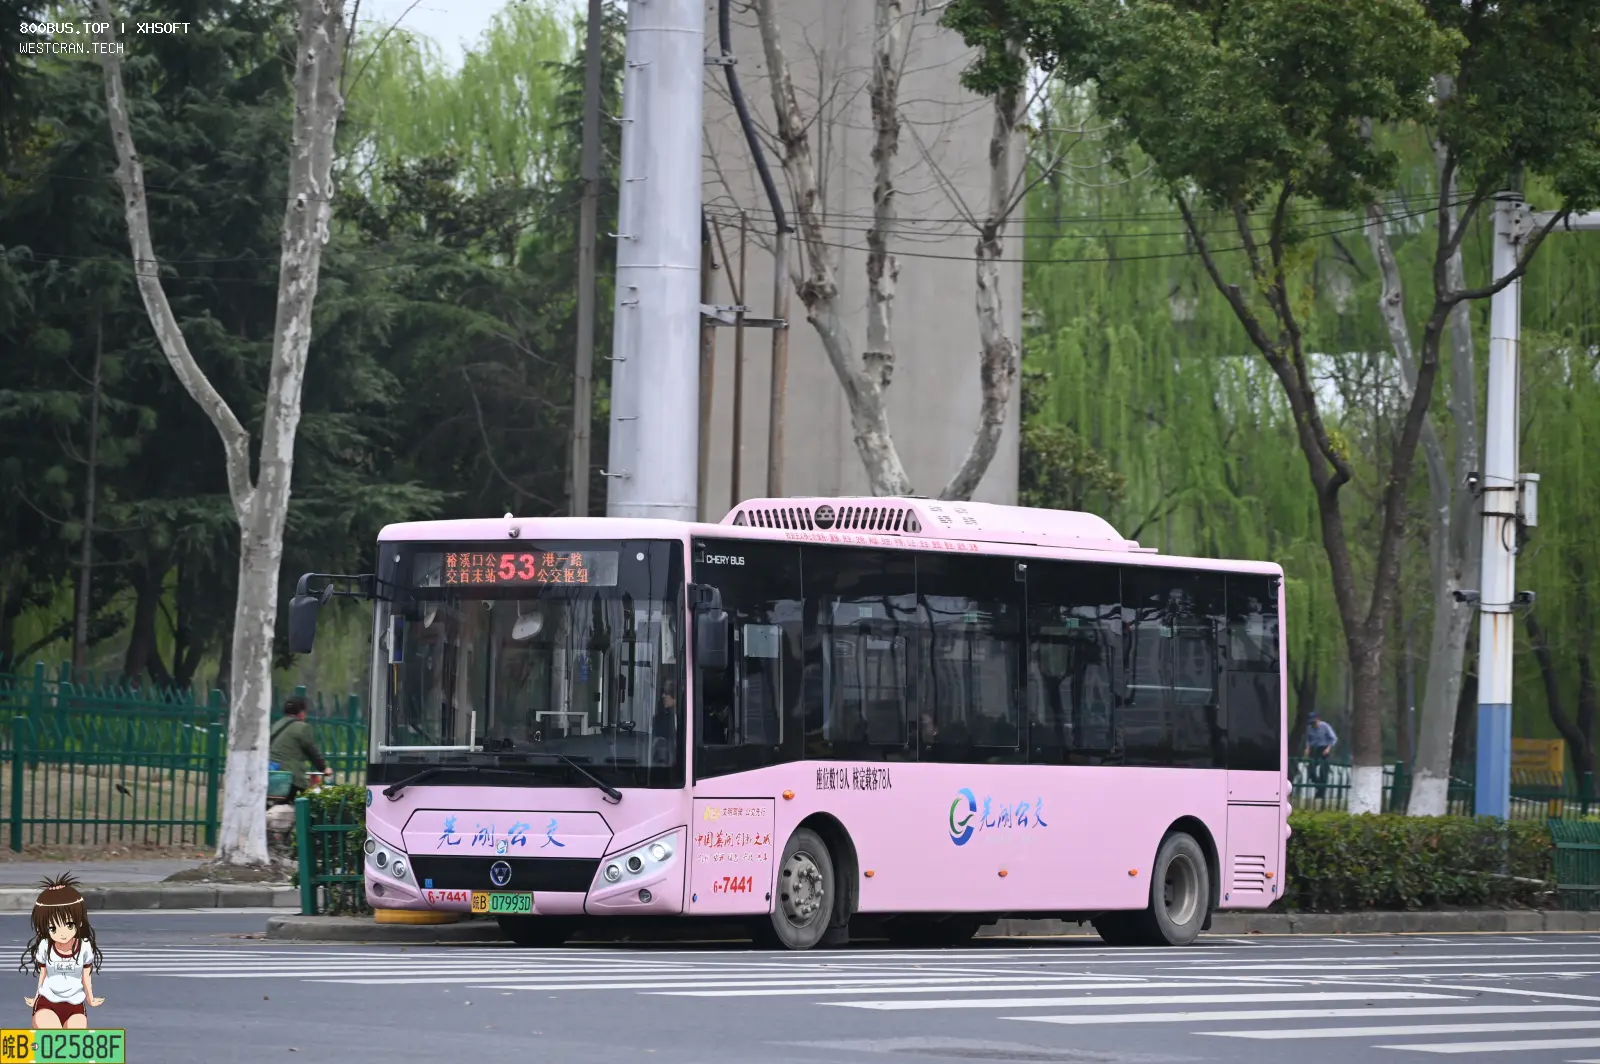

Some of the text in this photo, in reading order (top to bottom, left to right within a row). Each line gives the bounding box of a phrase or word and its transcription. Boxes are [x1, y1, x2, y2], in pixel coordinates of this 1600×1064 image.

[498, 553, 535, 581] 53
[542, 552, 583, 567] 港一路
[706, 554, 745, 566] CHERY BUS
[446, 568, 497, 583] 交首末站
[537, 568, 589, 583] 公交枢纽
[816, 766, 892, 791] 座位数19人 核定载客78人
[979, 794, 1048, 832] 芜湖公交
[437, 814, 566, 850] 芜湖公交
[713, 875, 753, 894] 6-7441
[427, 890, 468, 905] 6-7441
[491, 894, 531, 911] 07993D
